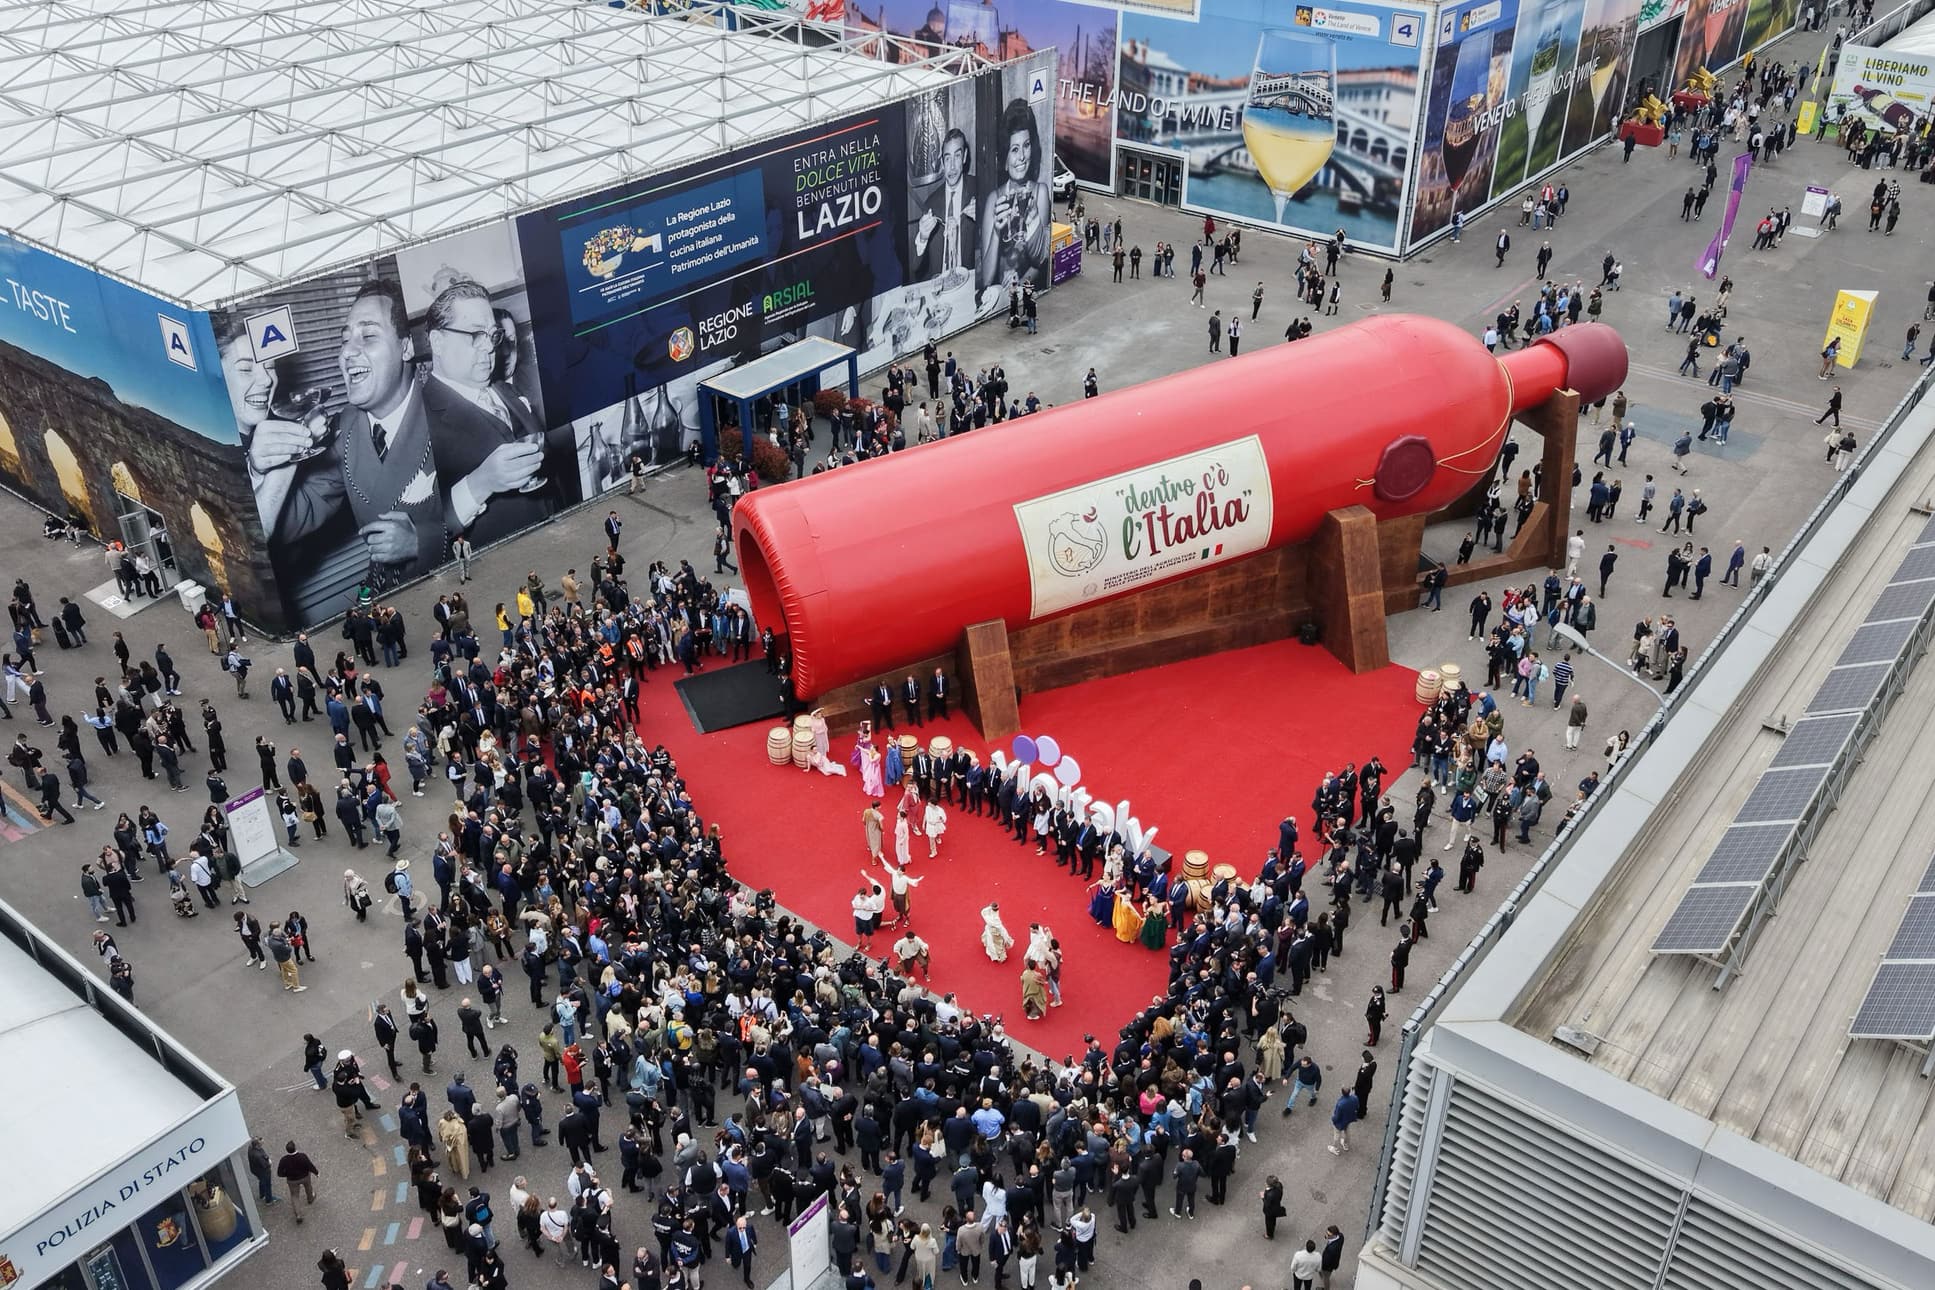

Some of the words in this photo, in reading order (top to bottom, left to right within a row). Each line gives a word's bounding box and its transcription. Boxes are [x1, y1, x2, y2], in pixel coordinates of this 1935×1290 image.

[1398, 24, 1413, 38] 4
[1444, 21, 1452, 35] 4
[1862, 71, 1871, 82] IL
[1876, 72, 1904, 86] VINO
[1865, 57, 1928, 77] LIBERIAMO
[1031, 78, 1044, 95] A
[1059, 78, 1094, 103] THE
[1097, 86, 1147, 113] LAND
[1150, 97, 1178, 118] OF
[1181, 101, 1234, 131] WINE
[794, 148, 836, 172] ENTRA
[840, 134, 880, 157] NELLA
[796, 161, 845, 192] DOLCE
[848, 151, 881, 174] VITA:
[796, 177, 858, 208] BENVENUTI
[861, 170, 881, 185] NEL
[666, 216, 677, 226] La
[677, 206, 709, 222] Regione
[710, 198, 731, 211] Lazio
[797, 185, 882, 240] LAZIO
[668, 219, 717, 245] protagonista
[717, 212, 736, 225] della
[669, 243, 695, 258] cucina
[695, 234, 723, 249] italiana
[671, 253, 713, 274] Patrimonio
[714, 235, 759, 259] dell'Umanità
[6, 278, 77, 334] TASTE
[763, 279, 815, 313] ARSIAL
[698, 301, 753, 336] REGIONE
[171, 332, 188, 356] A
[261, 324, 287, 348] A
[700, 325, 738, 351] LAZIO
[1202, 462, 1230, 491] c'è
[36, 1199, 117, 1257] POLIZIA
[119, 1180, 140, 1202] DI
[143, 1137, 206, 1187] STATO
